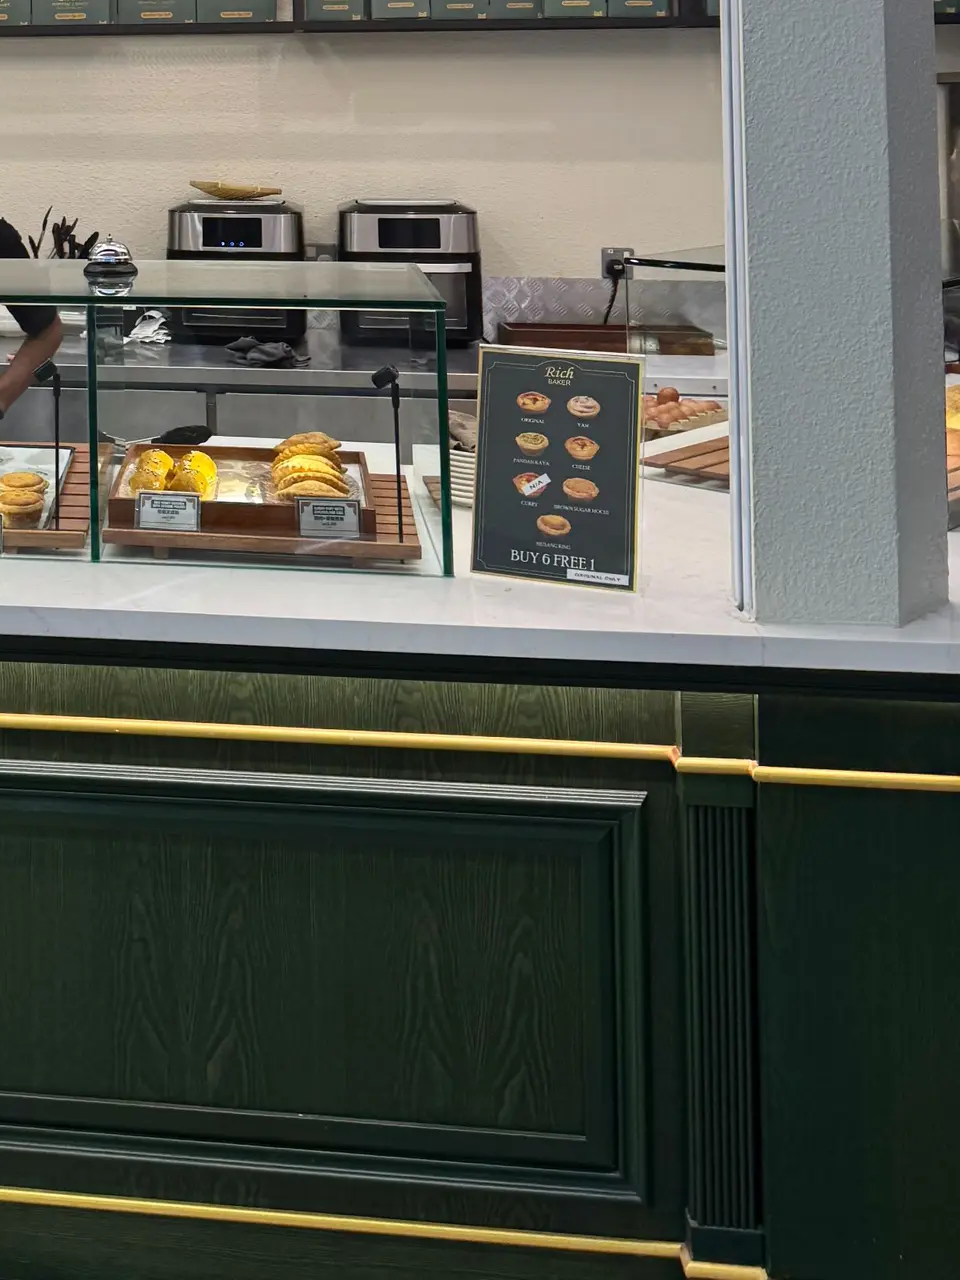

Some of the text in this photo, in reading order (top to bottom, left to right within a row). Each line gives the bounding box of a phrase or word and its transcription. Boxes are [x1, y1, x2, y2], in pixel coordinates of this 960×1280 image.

[544, 366, 574, 379] Rich
[511, 549, 595, 571] BUY 6 FREE 1
